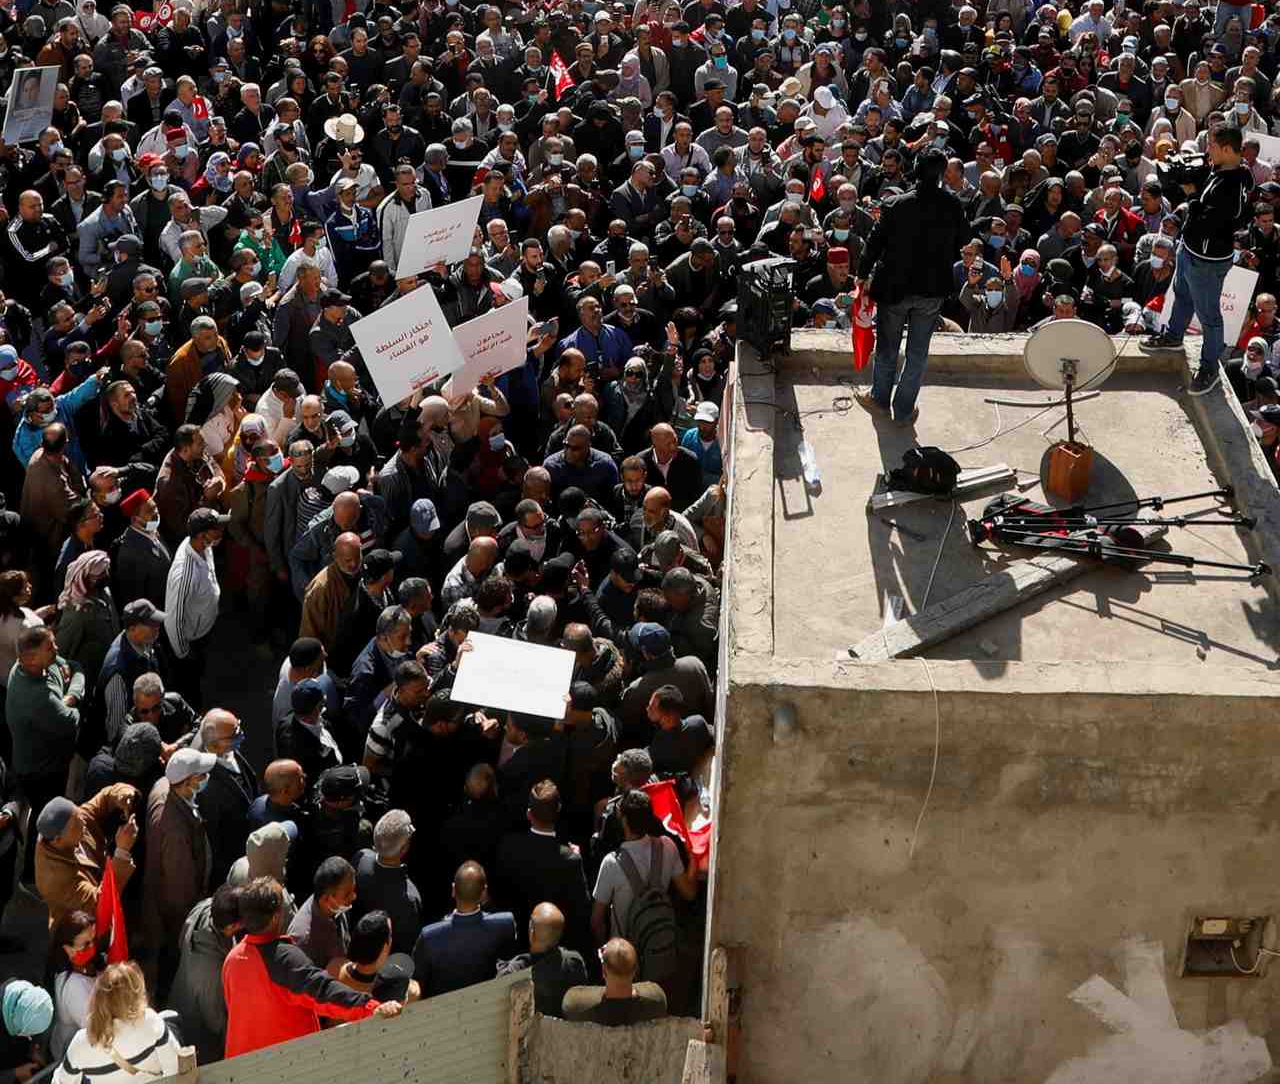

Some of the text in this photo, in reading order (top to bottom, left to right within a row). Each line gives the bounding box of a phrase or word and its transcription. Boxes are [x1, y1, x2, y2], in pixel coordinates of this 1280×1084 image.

[375, 318, 433, 355] احتكار السلطة
[419, 334, 430, 345] هو
